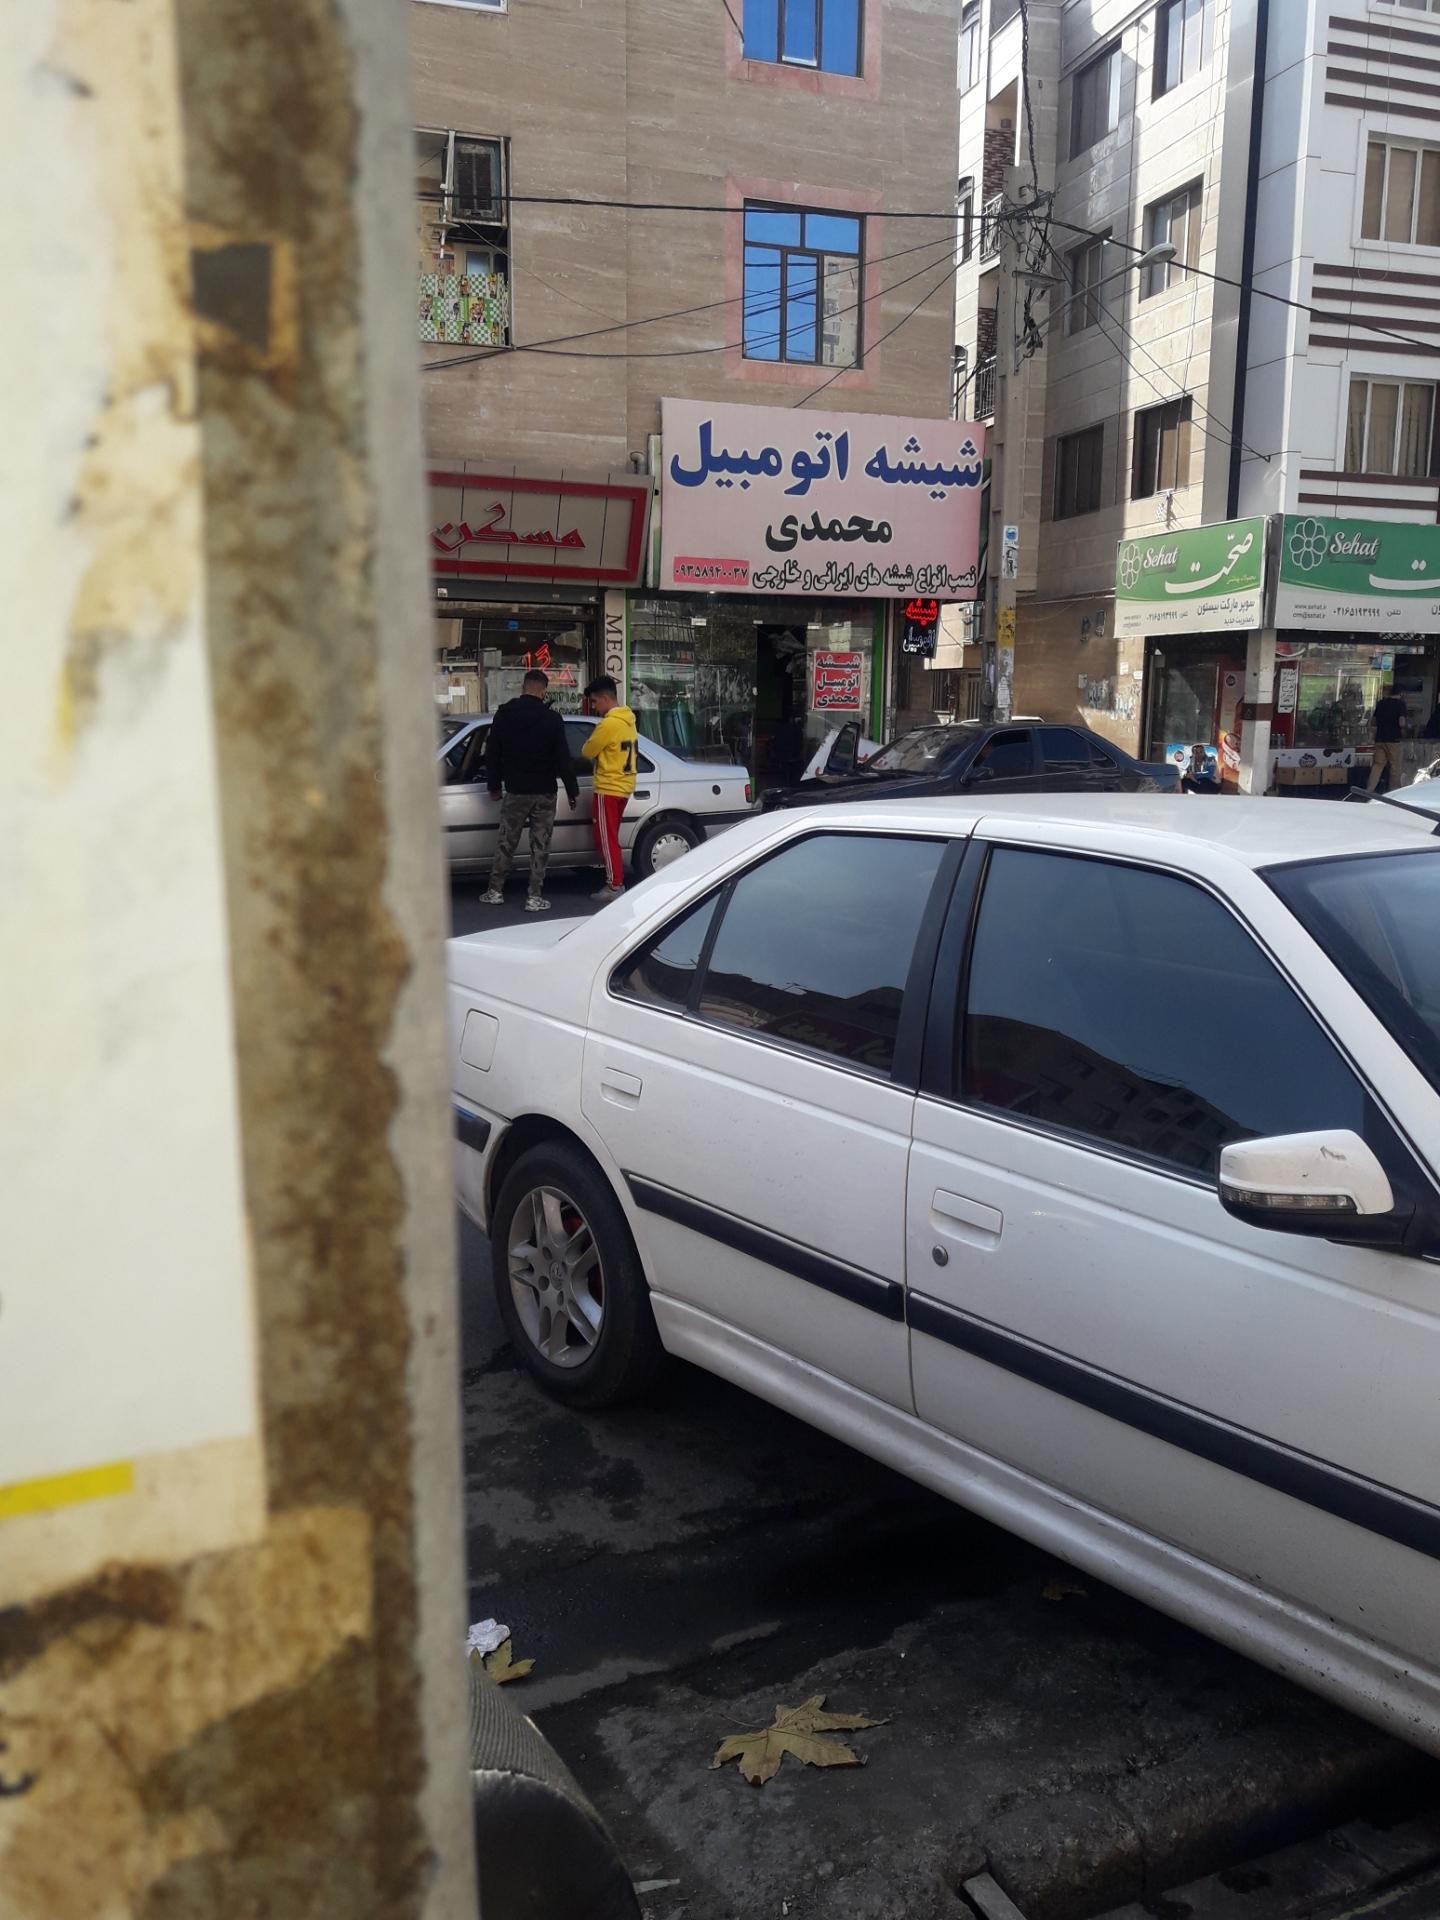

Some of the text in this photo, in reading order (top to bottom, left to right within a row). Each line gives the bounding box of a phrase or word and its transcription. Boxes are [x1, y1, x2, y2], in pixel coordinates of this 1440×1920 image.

[670, 420, 983, 500] شیشه اتومبیل
[431, 502, 586, 554] مسکن
[765, 510, 893, 552] محمدی
[1143, 544, 1179, 569] Sehat
[1330, 532, 1379, 556] Sehat
[675, 564, 748, 579] ۰۹۳۵۸۹۴۰۰۳۷
[752, 558, 977, 593] نصب انواع شیشه های ایرانی و خارجی
[905, 598, 938, 626] شیشه
[816, 654, 861, 673] شیشه
[816, 671, 860, 693] اتومبیل
[816, 694, 860, 708] محمدی
